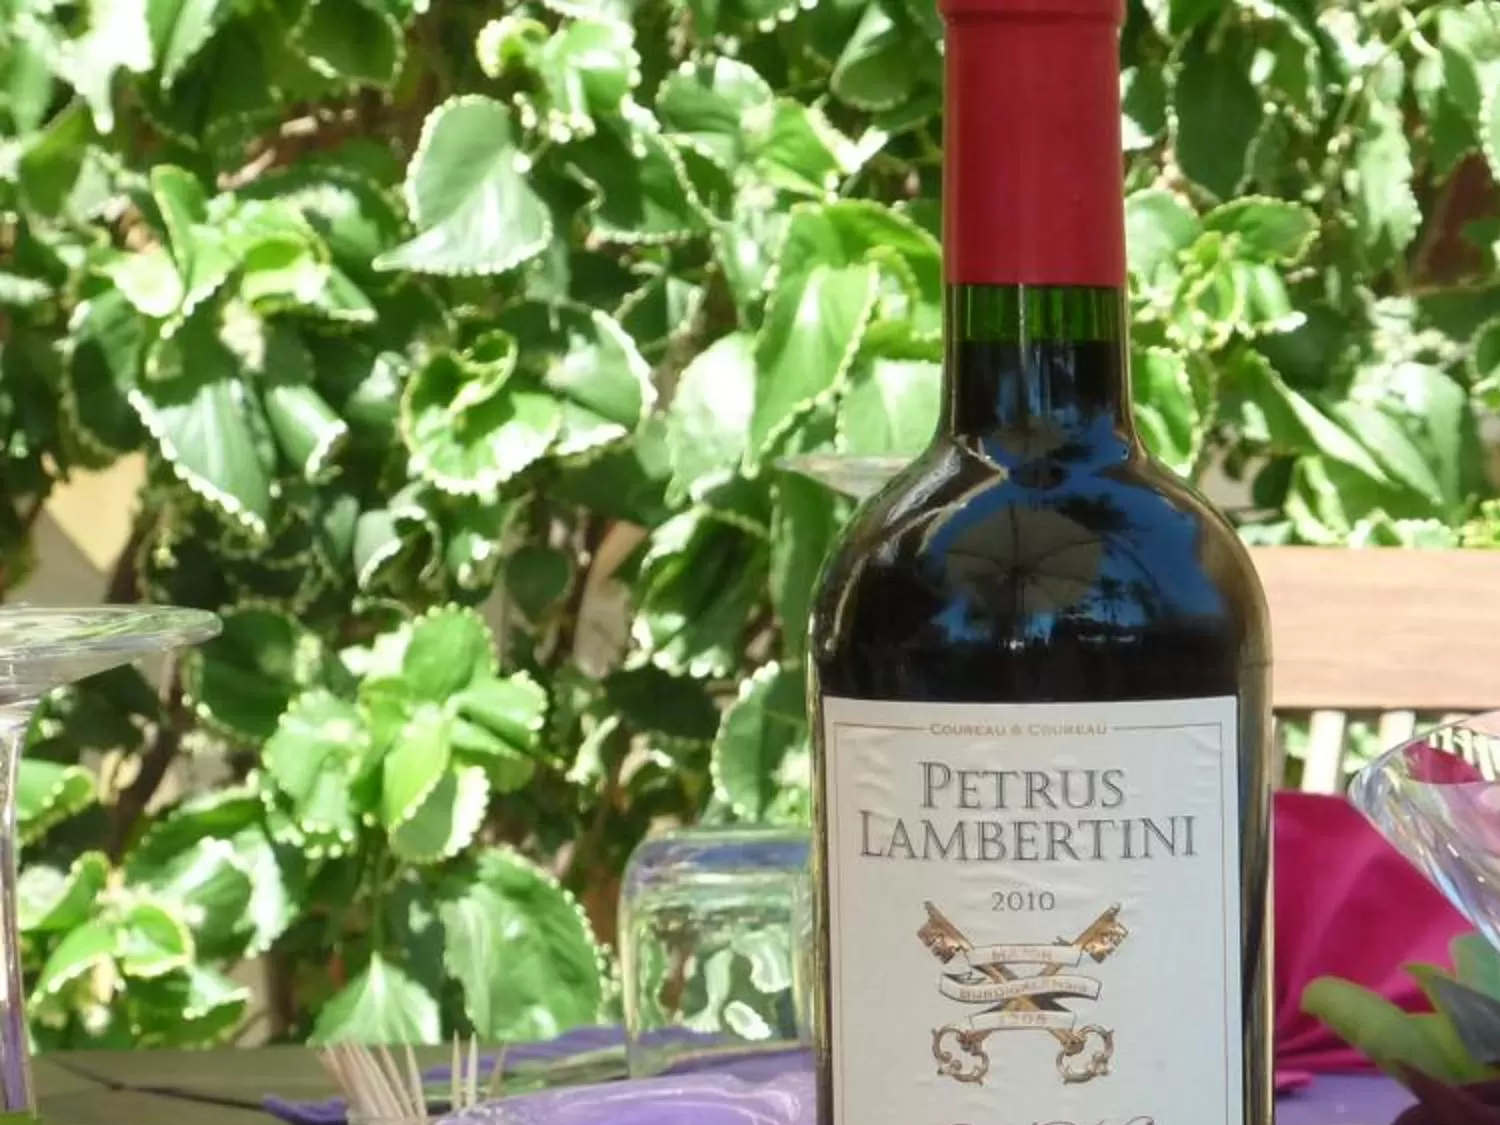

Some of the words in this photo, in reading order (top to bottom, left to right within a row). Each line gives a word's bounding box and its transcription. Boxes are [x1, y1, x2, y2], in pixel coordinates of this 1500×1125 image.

[918, 761, 1127, 809] PETRUS
[859, 809, 1199, 862] LAMBERTINI
[991, 890, 1056, 912] 2010
